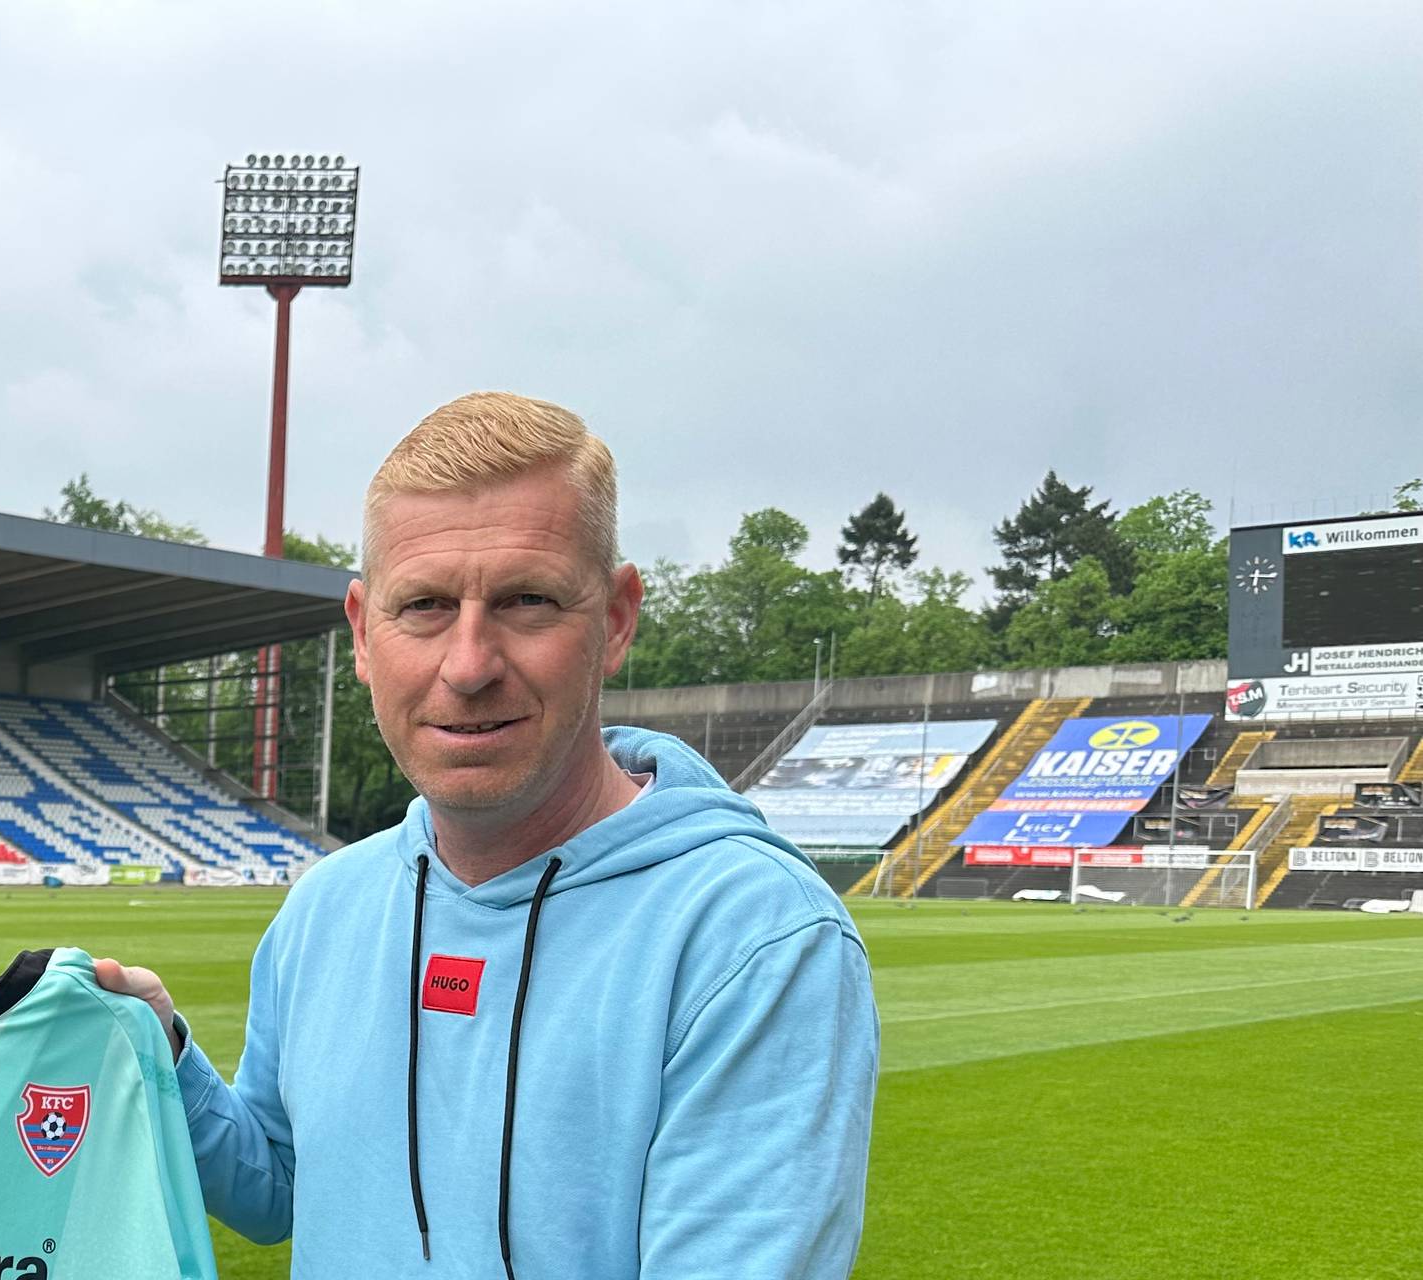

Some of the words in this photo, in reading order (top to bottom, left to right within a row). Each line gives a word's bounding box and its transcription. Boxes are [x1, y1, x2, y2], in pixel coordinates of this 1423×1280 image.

[1326, 526, 1419, 544] Willkommen
[1315, 650, 1354, 660] JOSEF
[1279, 683, 1342, 696] Terhaart
[1347, 680, 1408, 696] Security
[1028, 750, 1178, 777] KAISER
[1021, 823, 1066, 833] KICK
[1311, 851, 1357, 862] BELTONA
[430, 975, 470, 992] HUGO
[41, 1096, 74, 1110] KFC
